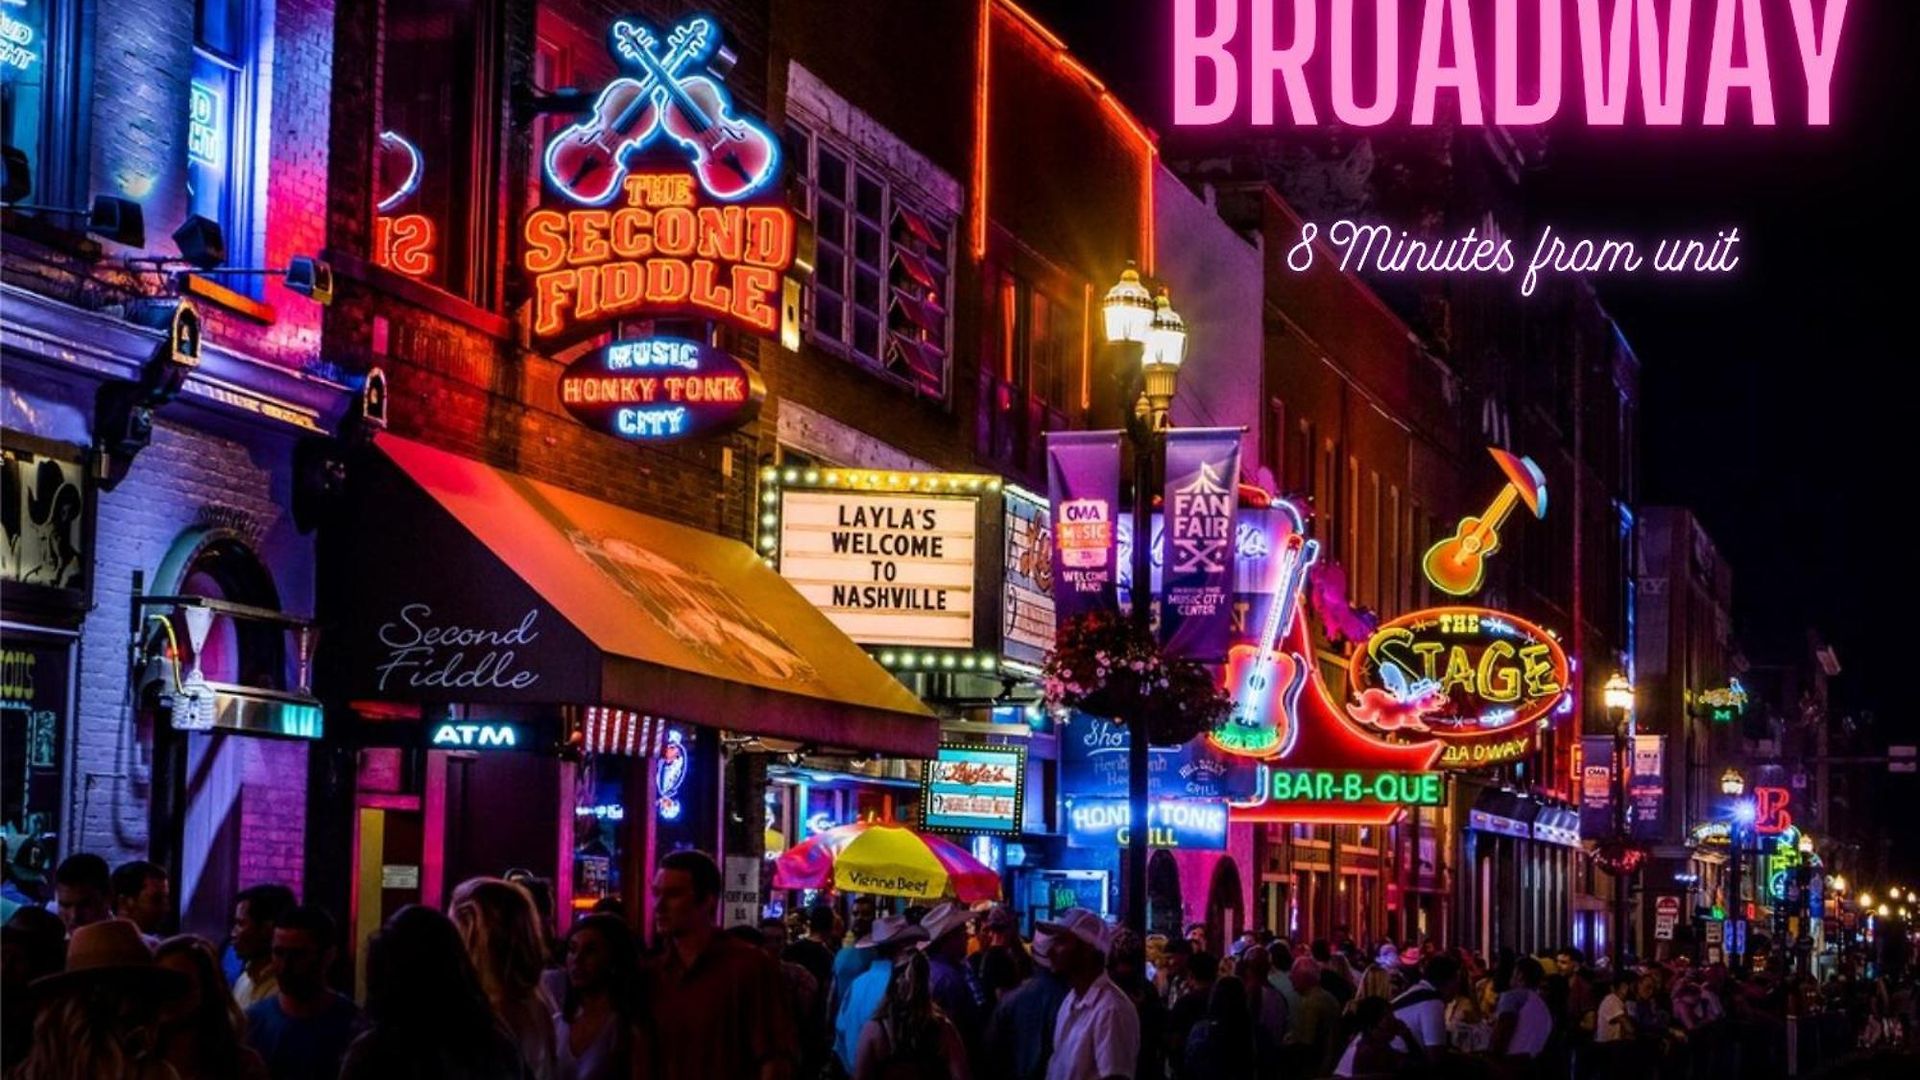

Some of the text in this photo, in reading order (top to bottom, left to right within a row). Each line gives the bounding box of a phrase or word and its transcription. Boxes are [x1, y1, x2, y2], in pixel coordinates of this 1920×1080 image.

[624, 174, 695, 207] THE
[525, 205, 793, 272] SECOND
[535, 258, 778, 335] FIDDLE
[608, 341, 699, 370] MUSIC
[563, 376, 745, 403] HONKY TONK
[617, 407, 686, 436] CITY
[838, 505, 937, 530] LAYLA'S
[1066, 505, 1100, 521] CMA
[1174, 495, 1230, 516] FAN
[1173, 516, 1228, 538] FAIR
[831, 532, 944, 558] WELCOME
[871, 560, 896, 582] TO
[1062, 570, 1109, 582] WELCOME
[832, 585, 948, 610] NASHVILLE
[377, 603, 540, 649] Second
[1439, 613, 1479, 633] THE
[375, 646, 541, 692] Fiddle
[1367, 626, 1562, 702] STAGE
[432, 724, 516, 746] ATM
[1272, 771, 1441, 803] BAR-B-QUE
[1158, 803, 1227, 832] TONK
[848, 870, 929, 896] Vienna Beef
